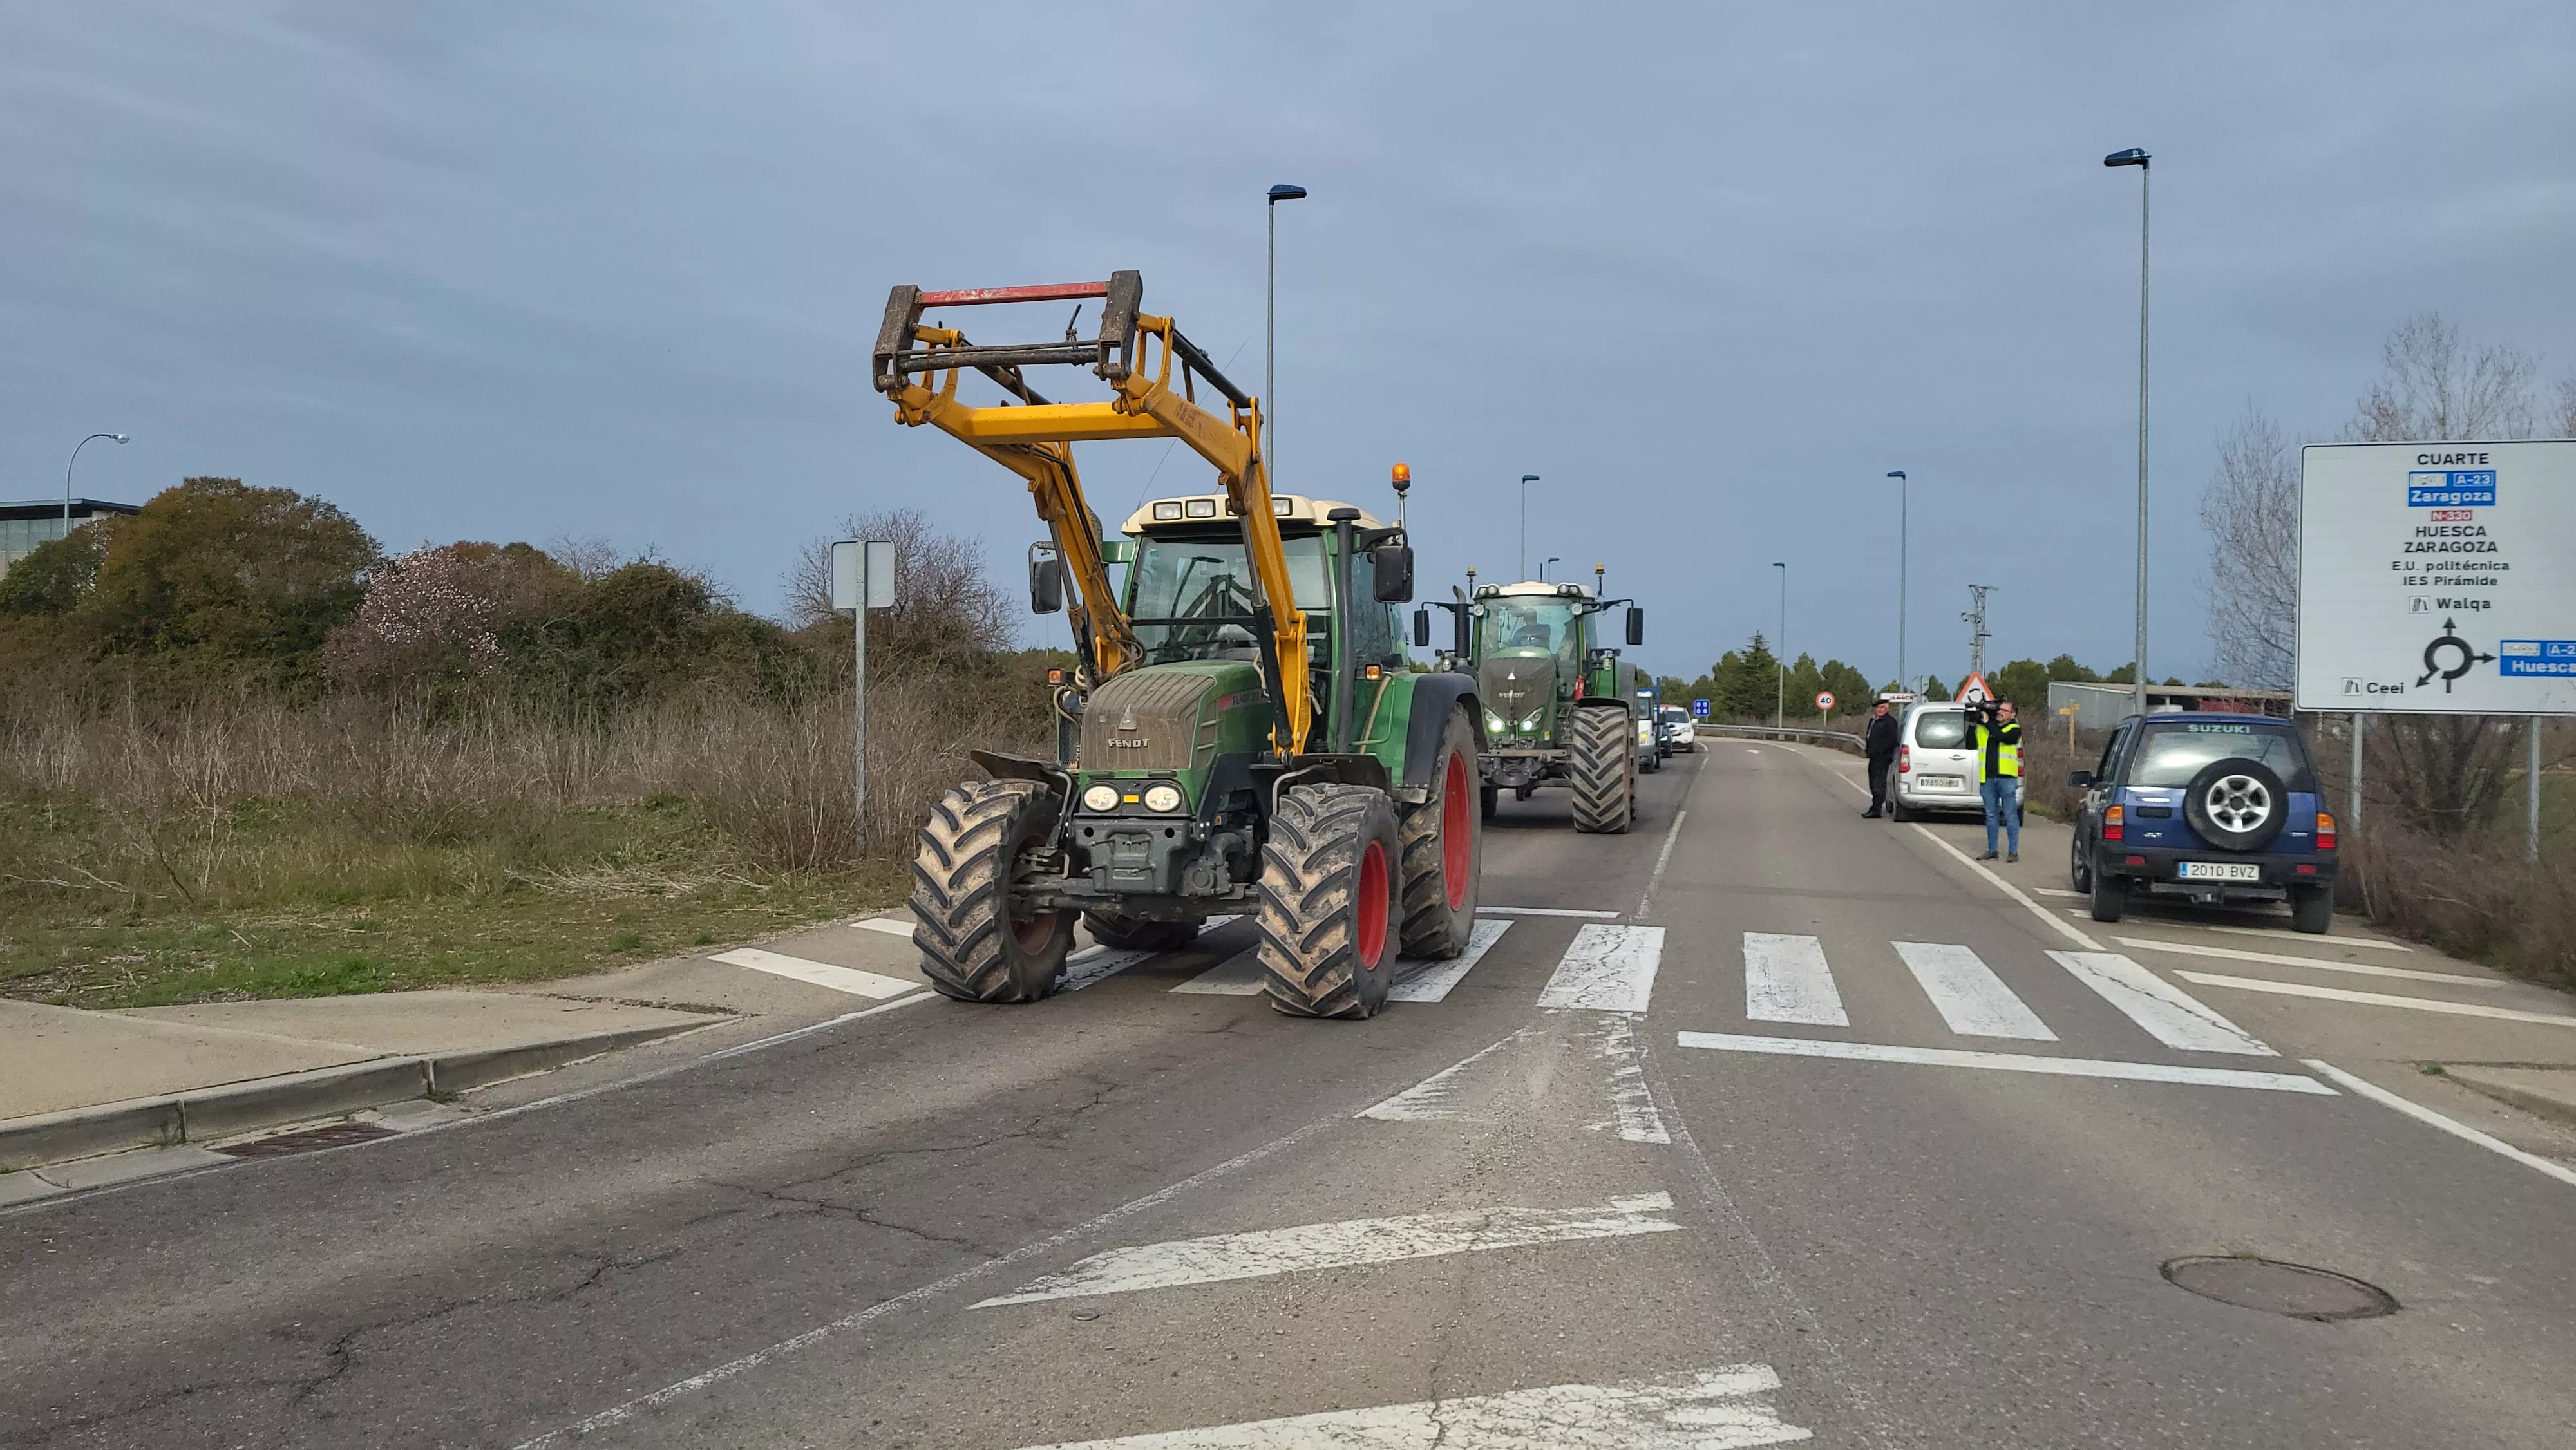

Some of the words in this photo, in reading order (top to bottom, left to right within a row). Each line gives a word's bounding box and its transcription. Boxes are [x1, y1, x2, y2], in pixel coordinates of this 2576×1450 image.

[2417, 453, 2490, 465] CUARTE
[2456, 475, 2491, 484] A-23
[2410, 489, 2492, 505] Zaragoza
[2432, 511, 2472, 520] N-330
[2416, 525, 2487, 537] HUESCA
[2404, 541, 2499, 552] ZARAGOZA
[2392, 561, 2420, 570] E.U.
[2426, 560, 2510, 572] politécnica
[2403, 576, 2429, 585] IES
[2434, 574, 2499, 585] Pirámide
[2436, 597, 2492, 612] Walqa
[2367, 682, 2405, 694] Ceei
[2187, 724, 2251, 734] SUZUKI
[1107, 738, 1150, 748] FENDT
[2192, 865, 2224, 876] 2010
[2230, 866, 2255, 878] BVZ
